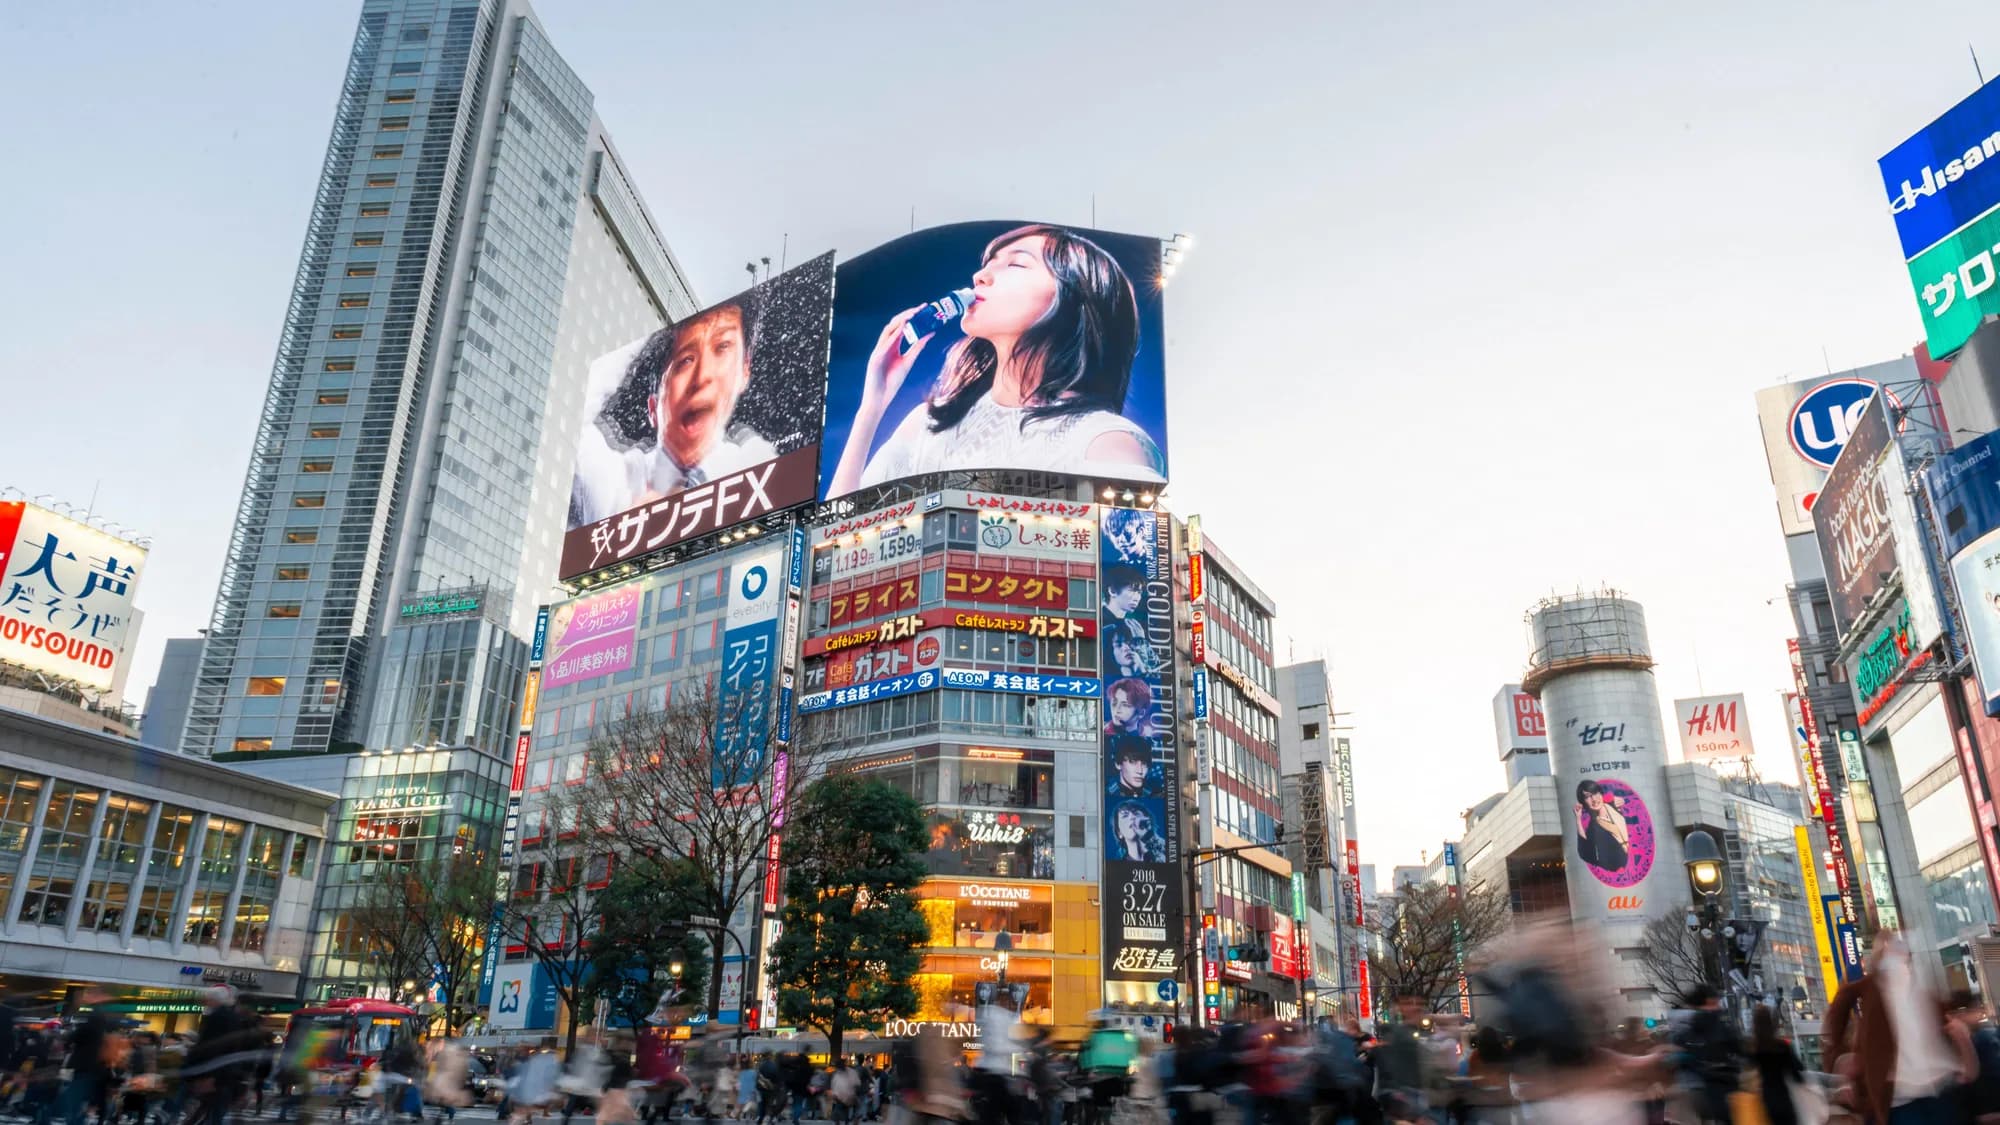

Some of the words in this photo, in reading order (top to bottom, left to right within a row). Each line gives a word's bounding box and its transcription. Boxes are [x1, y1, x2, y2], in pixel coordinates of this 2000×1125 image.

[1922, 243, 2000, 318] サロ
[1950, 445, 1992, 476] Channel
[617, 462, 777, 558] サンテFX
[967, 493, 1091, 517] しゃぶしゃぶバイキング
[1018, 524, 1092, 551] しゃぶ葉
[1157, 517, 1169, 548] BULLET
[13, 532, 136, 598] 大声
[815, 556, 831, 572] 9F
[1158, 554, 1170, 580] TRAIN
[832, 579, 917, 620] プライス
[946, 571, 1065, 602] コンタクト
[590, 594, 635, 618] 品川スキン
[588, 609, 629, 632] クリニック
[880, 614, 924, 642] ガスト
[1028, 616, 1084, 639] ガスト
[1146, 582, 1173, 680] GOLDEN
[556, 644, 628, 679] 品川美容外科
[855, 648, 908, 683] ガスト
[919, 648, 938, 659] ガスト
[806, 667, 825, 687] 7F
[949, 672, 984, 685] AEON
[993, 673, 1098, 694] 英会話イーオン
[835, 679, 914, 705] 英会話イーオン
[1686, 701, 1737, 736] H&M
[1578, 720, 1625, 746] ゼロ!
[1340, 743, 1348, 760] BIC
[1620, 744, 1646, 753] キュー
[1695, 742, 1728, 753] 150m
[377, 786, 427, 797] SHIBUYA
[1341, 762, 1353, 807] CAMERA
[351, 797, 402, 811] MARK
[410, 794, 454, 807] CITY
[960, 884, 1031, 900] L'OCCITANE
[1123, 882, 1167, 912] 3.27
[1608, 895, 1644, 911] au
[1123, 912, 1137, 927] ON
[1139, 913, 1166, 928] SALE
